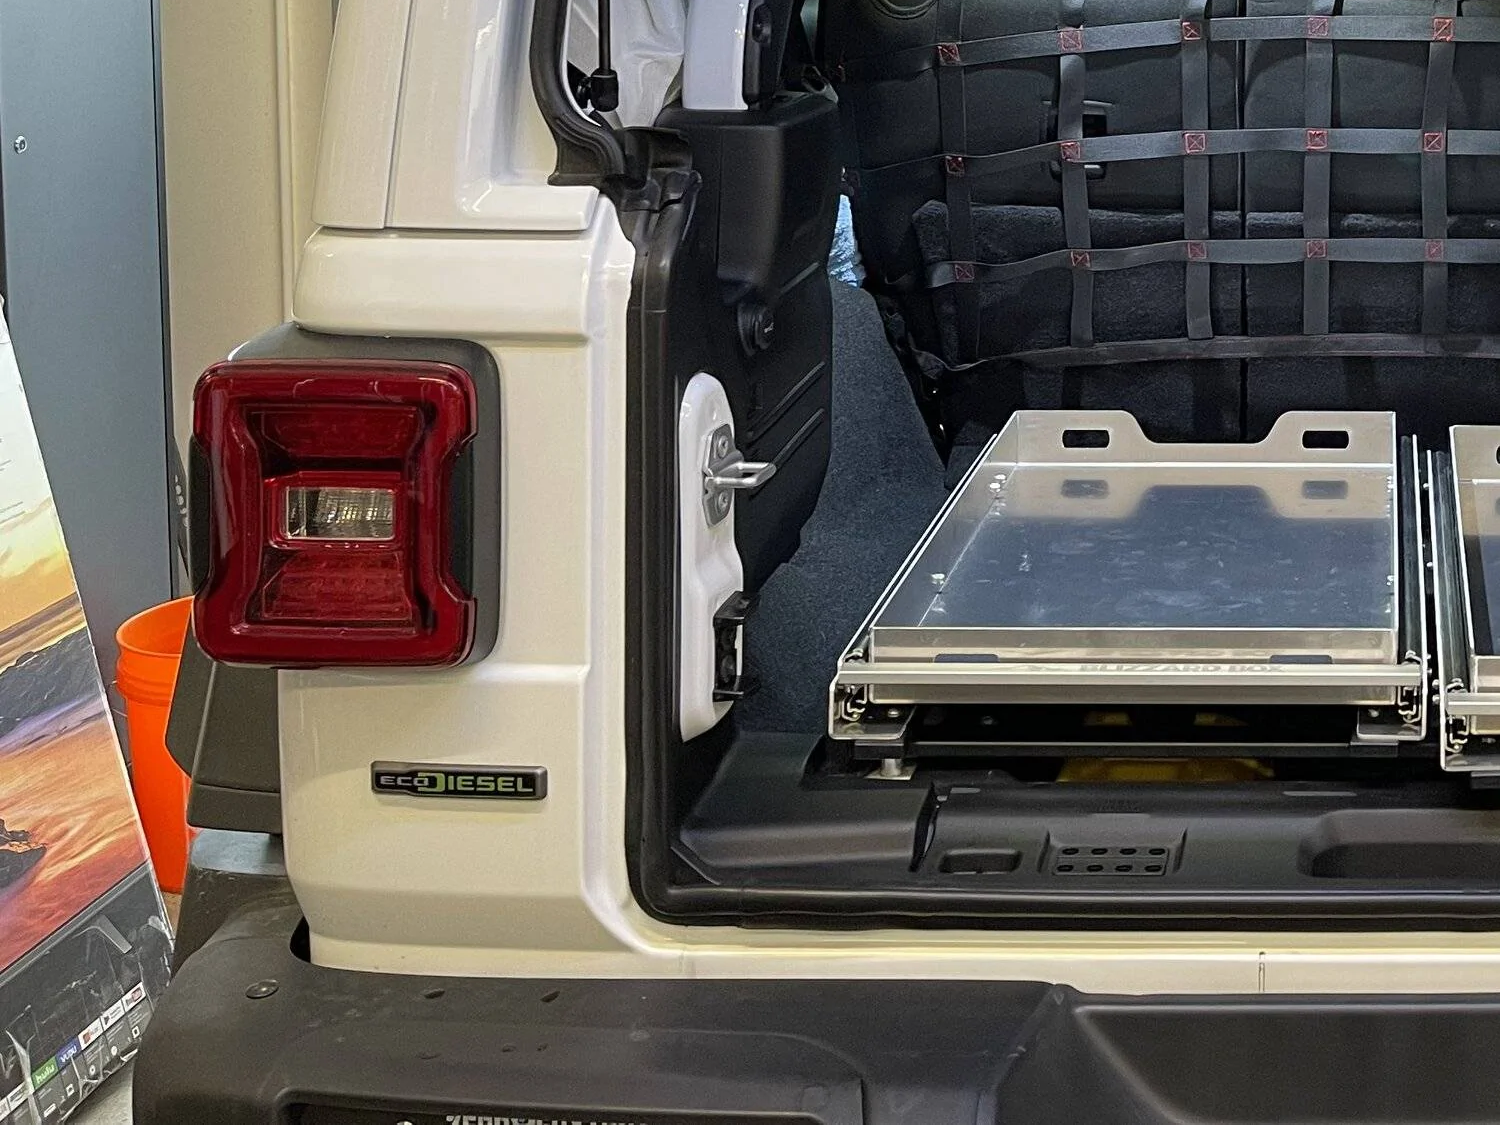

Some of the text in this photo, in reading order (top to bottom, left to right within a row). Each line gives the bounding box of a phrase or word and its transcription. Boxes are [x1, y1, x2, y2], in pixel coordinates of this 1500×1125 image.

[1079, 663, 1284, 673] BLIZZARD BOX
[35, 1064, 55, 1084] hulu
